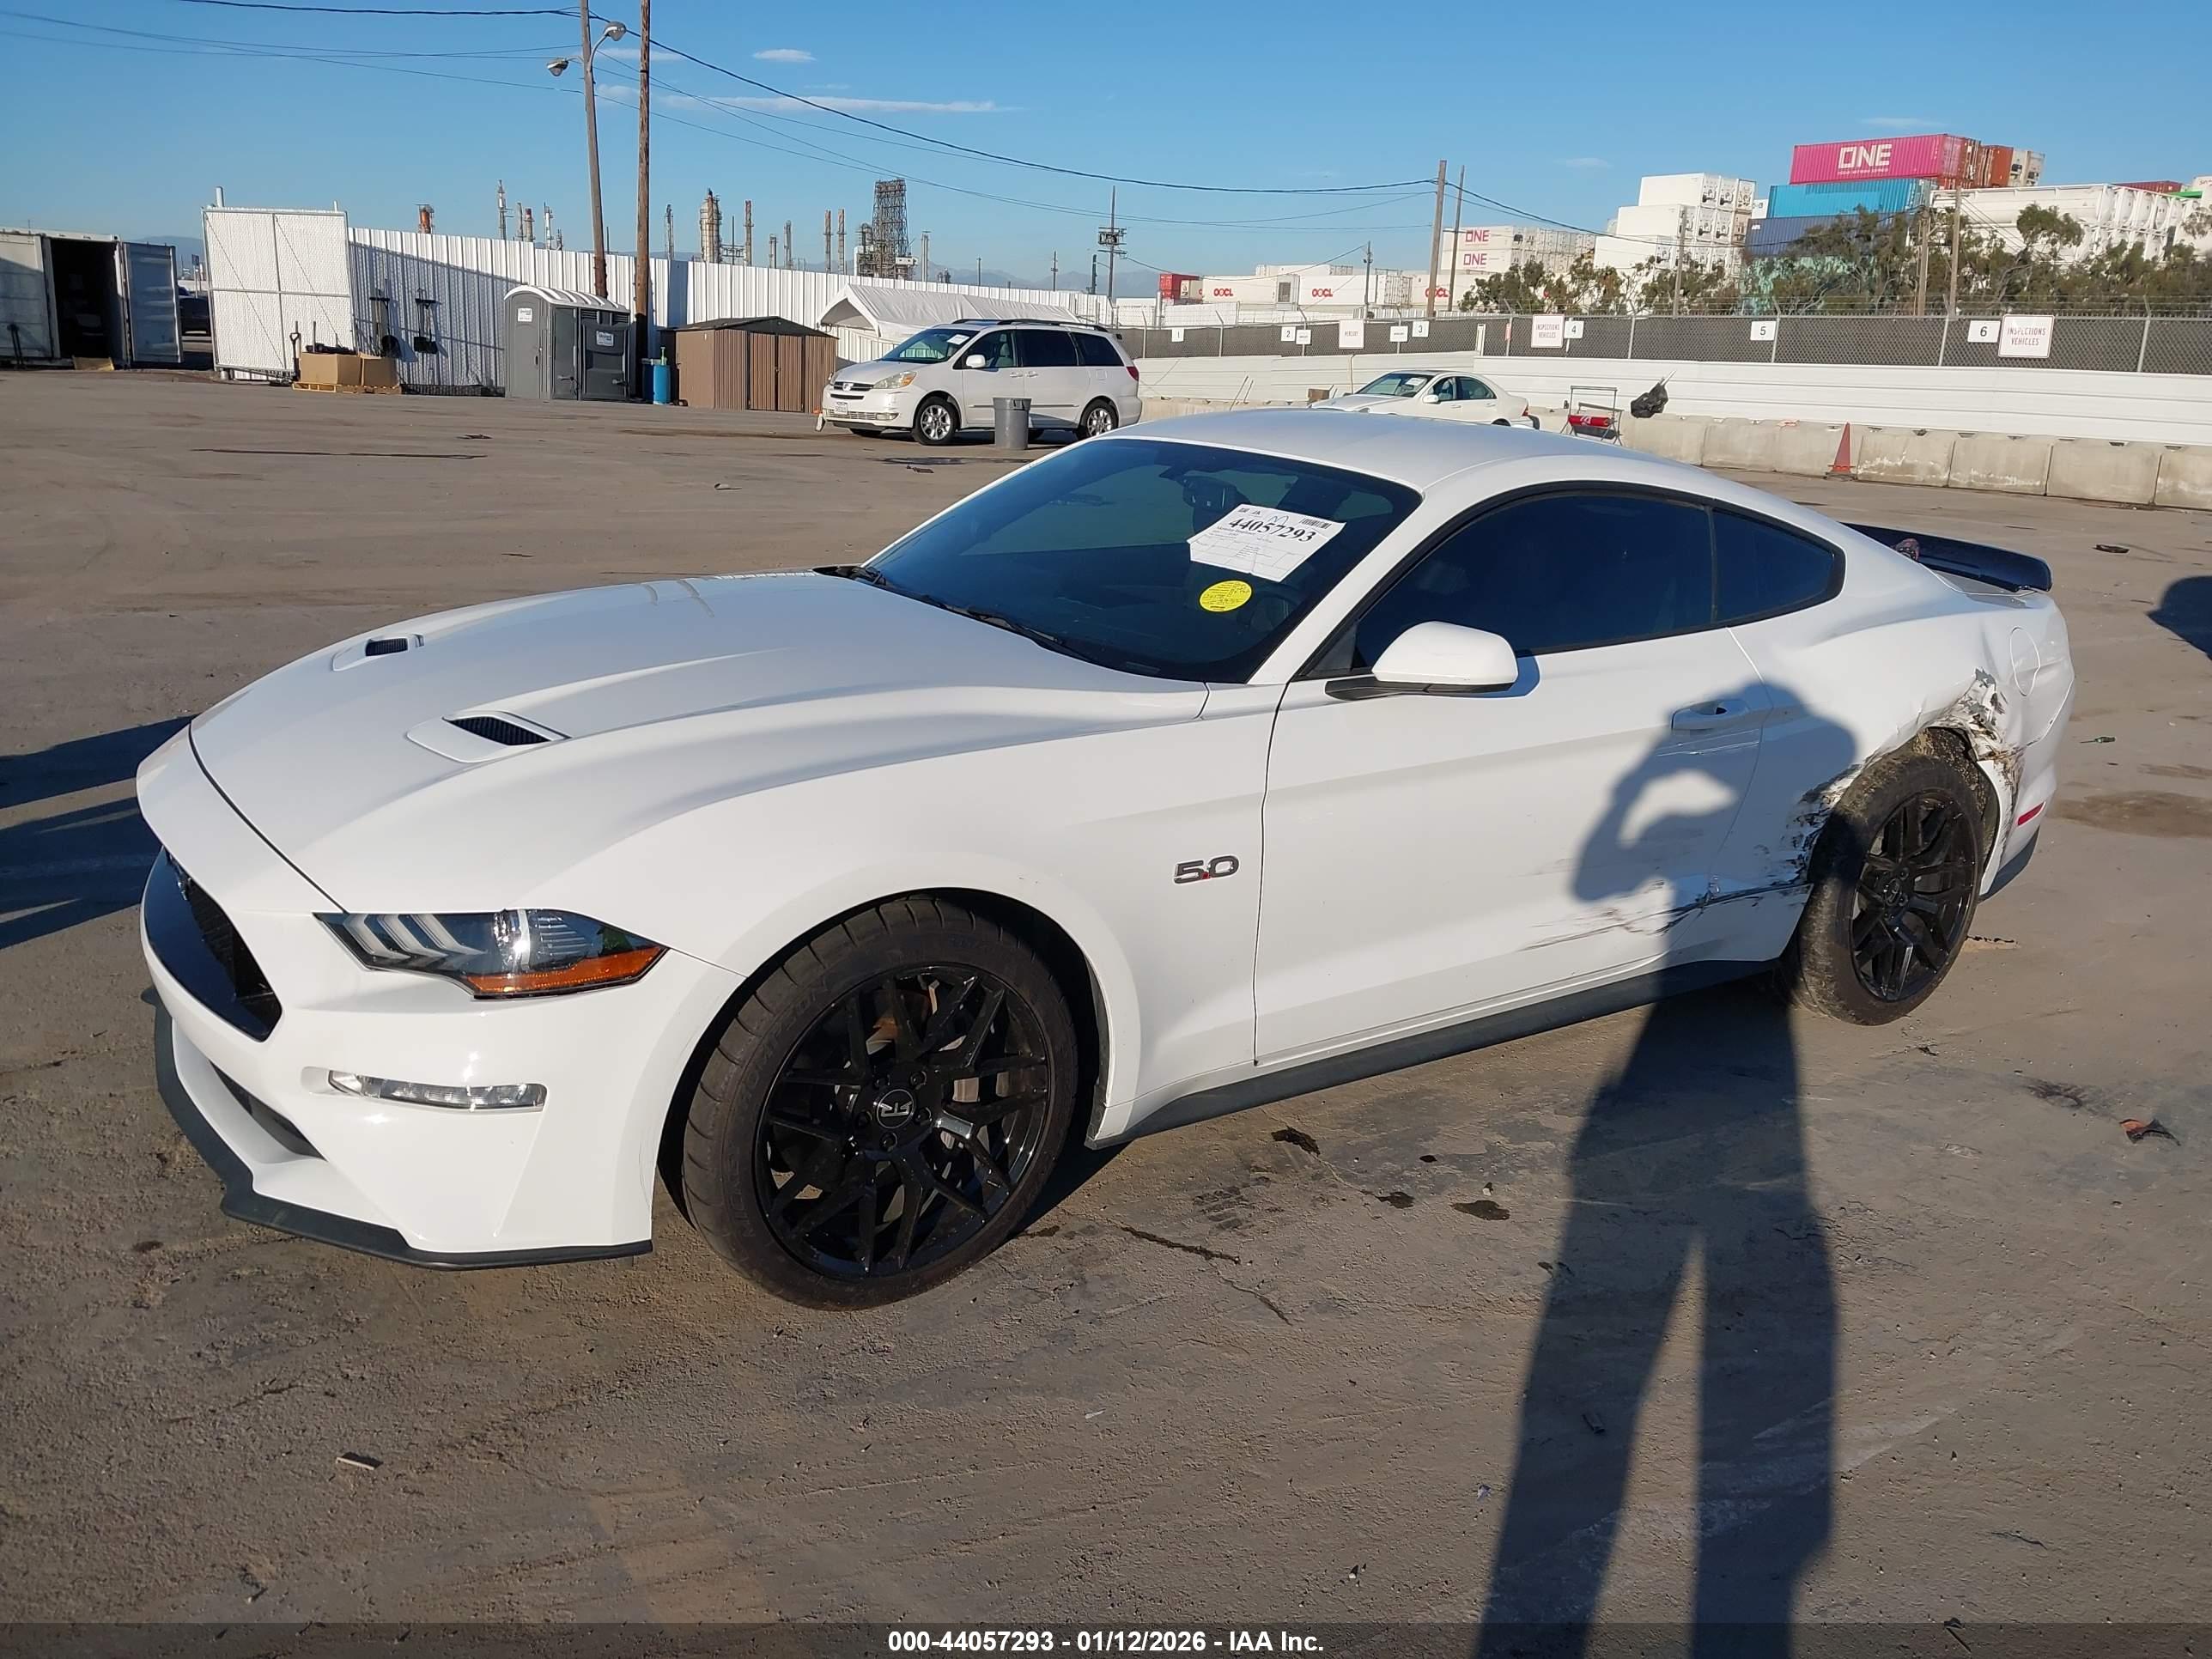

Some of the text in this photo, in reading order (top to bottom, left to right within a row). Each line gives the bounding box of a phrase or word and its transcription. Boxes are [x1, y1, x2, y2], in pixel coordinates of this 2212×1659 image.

[1838, 144, 1892, 169] ONE
[1466, 229, 1490, 242] ONE
[1463, 253, 1487, 265] ONE
[1213, 288, 1234, 297] OOCL
[1311, 288, 1333, 297] OOCL
[1425, 288, 1449, 297] OCL
[1418, 325, 1423, 333] 3
[1571, 325, 1577, 334] 4
[1760, 326, 1766, 336] 5
[1979, 326, 1988, 337] 6
[1286, 330, 1291, 338] 2
[2011, 337, 2039, 346] VEHICLES
[1229, 518, 1316, 542] 44057293
[1174, 855, 1239, 884] 5.0
